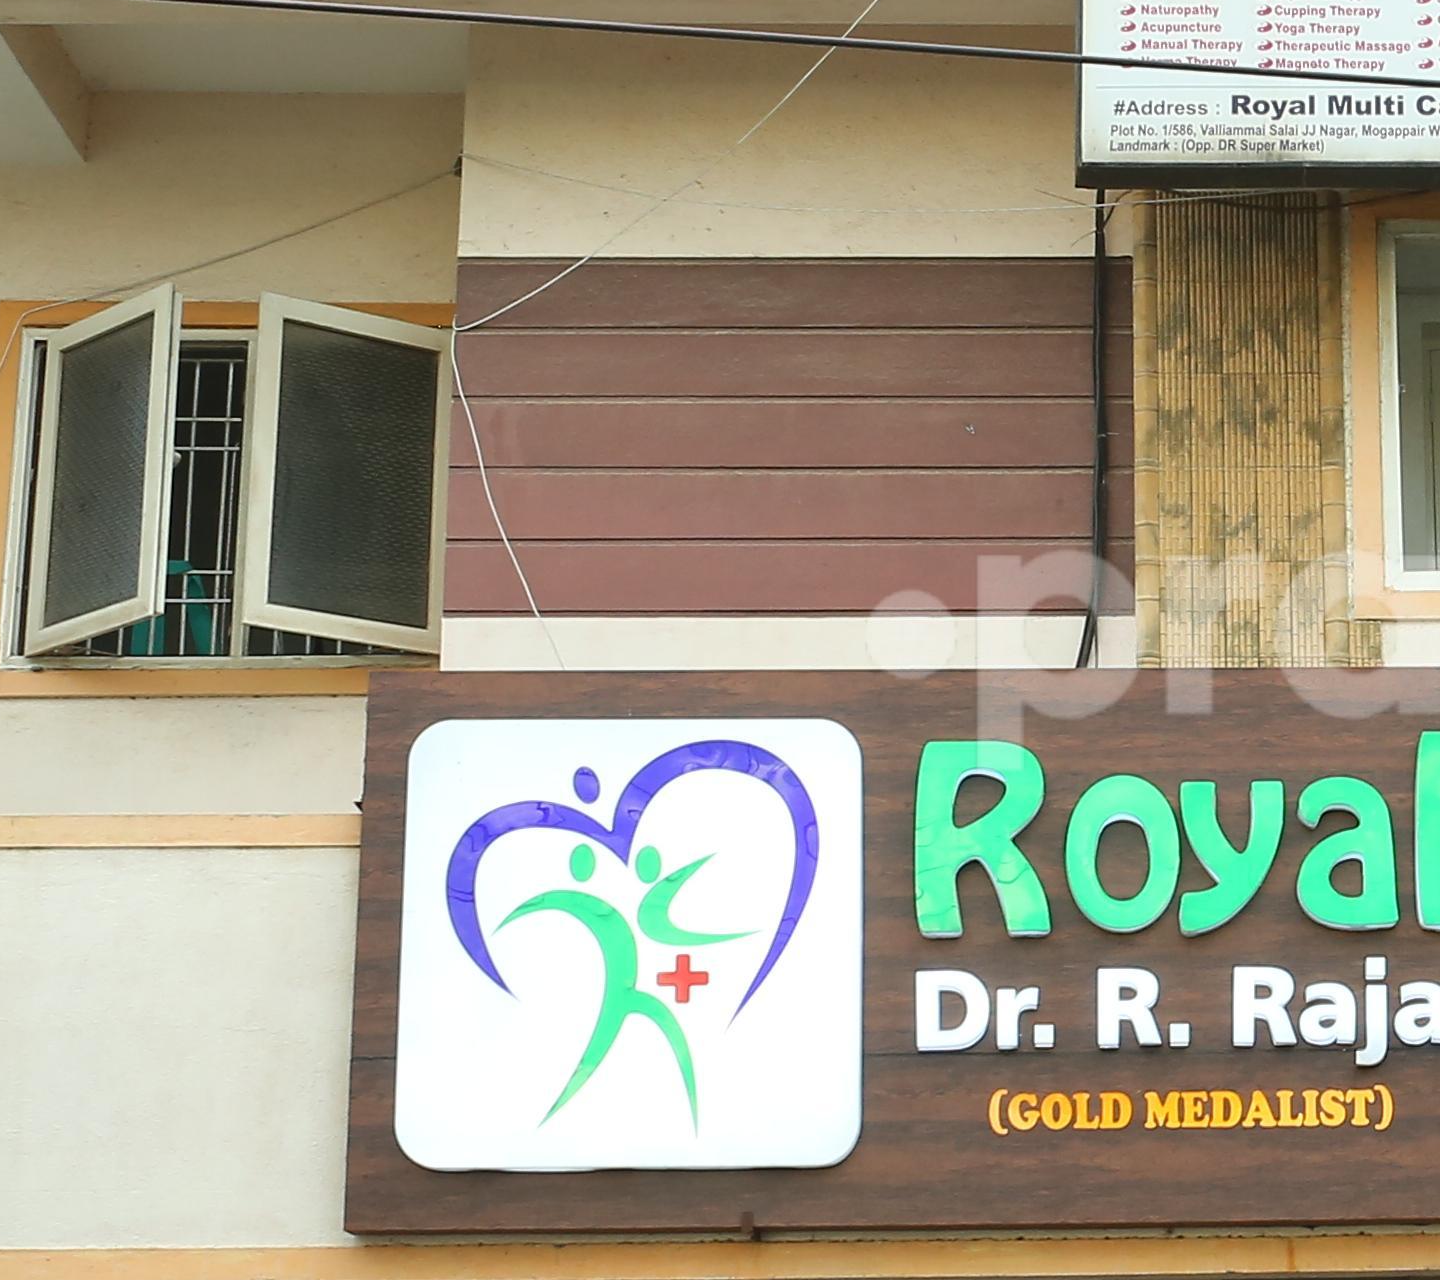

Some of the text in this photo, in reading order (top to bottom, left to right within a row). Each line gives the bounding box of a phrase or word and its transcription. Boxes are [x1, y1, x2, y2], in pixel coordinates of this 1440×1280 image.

[1141, 5, 1219, 18] Naturopathy
[1274, 6, 1380, 18] Cupping Therapy
[1141, 23, 1222, 35] Acupuncture
[1275, 23, 1360, 36] Yoga Therapy
[1142, 40, 1243, 52] Manual Therapy
[1276, 40, 1411, 53] Therapeutic Massage
[1334, 59, 1385, 71] Therapy
[1113, 100, 1209, 116] #Address
[1231, 94, 1315, 120] Royal
[1328, 94, 1405, 116] Multi
[914, 968, 1055, 1052] Dr.
[1096, 967, 1190, 1048] R.
[988, 1083, 1395, 1135] (GOLD MEDALIST)
